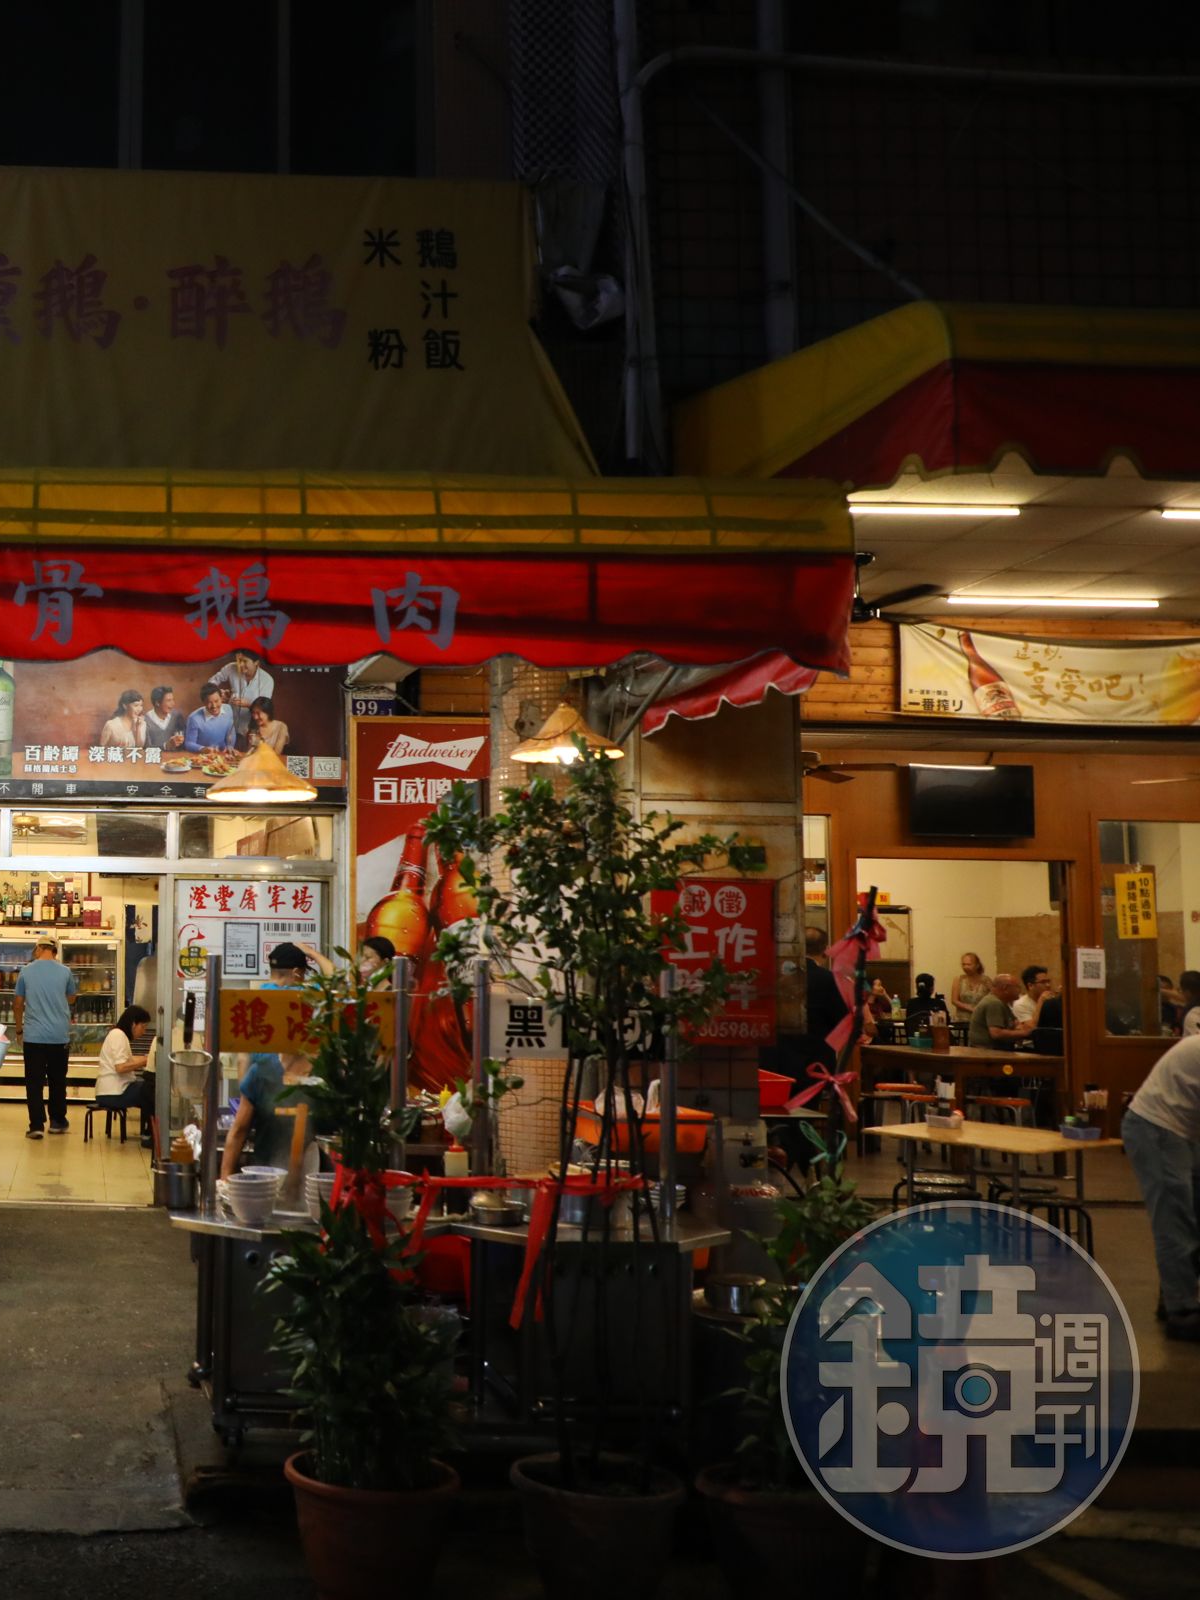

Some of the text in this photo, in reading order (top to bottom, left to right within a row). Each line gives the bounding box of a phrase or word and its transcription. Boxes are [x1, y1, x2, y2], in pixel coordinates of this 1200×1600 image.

[363, 228, 407, 371] 米粉
[416, 228, 465, 371] 鵝汁飯
[908, 698, 963, 712] 一番搾り
[386, 741, 478, 758] Budweiser
[373, 777, 478, 804] 百威啤
[668, 922, 758, 963] 工作
